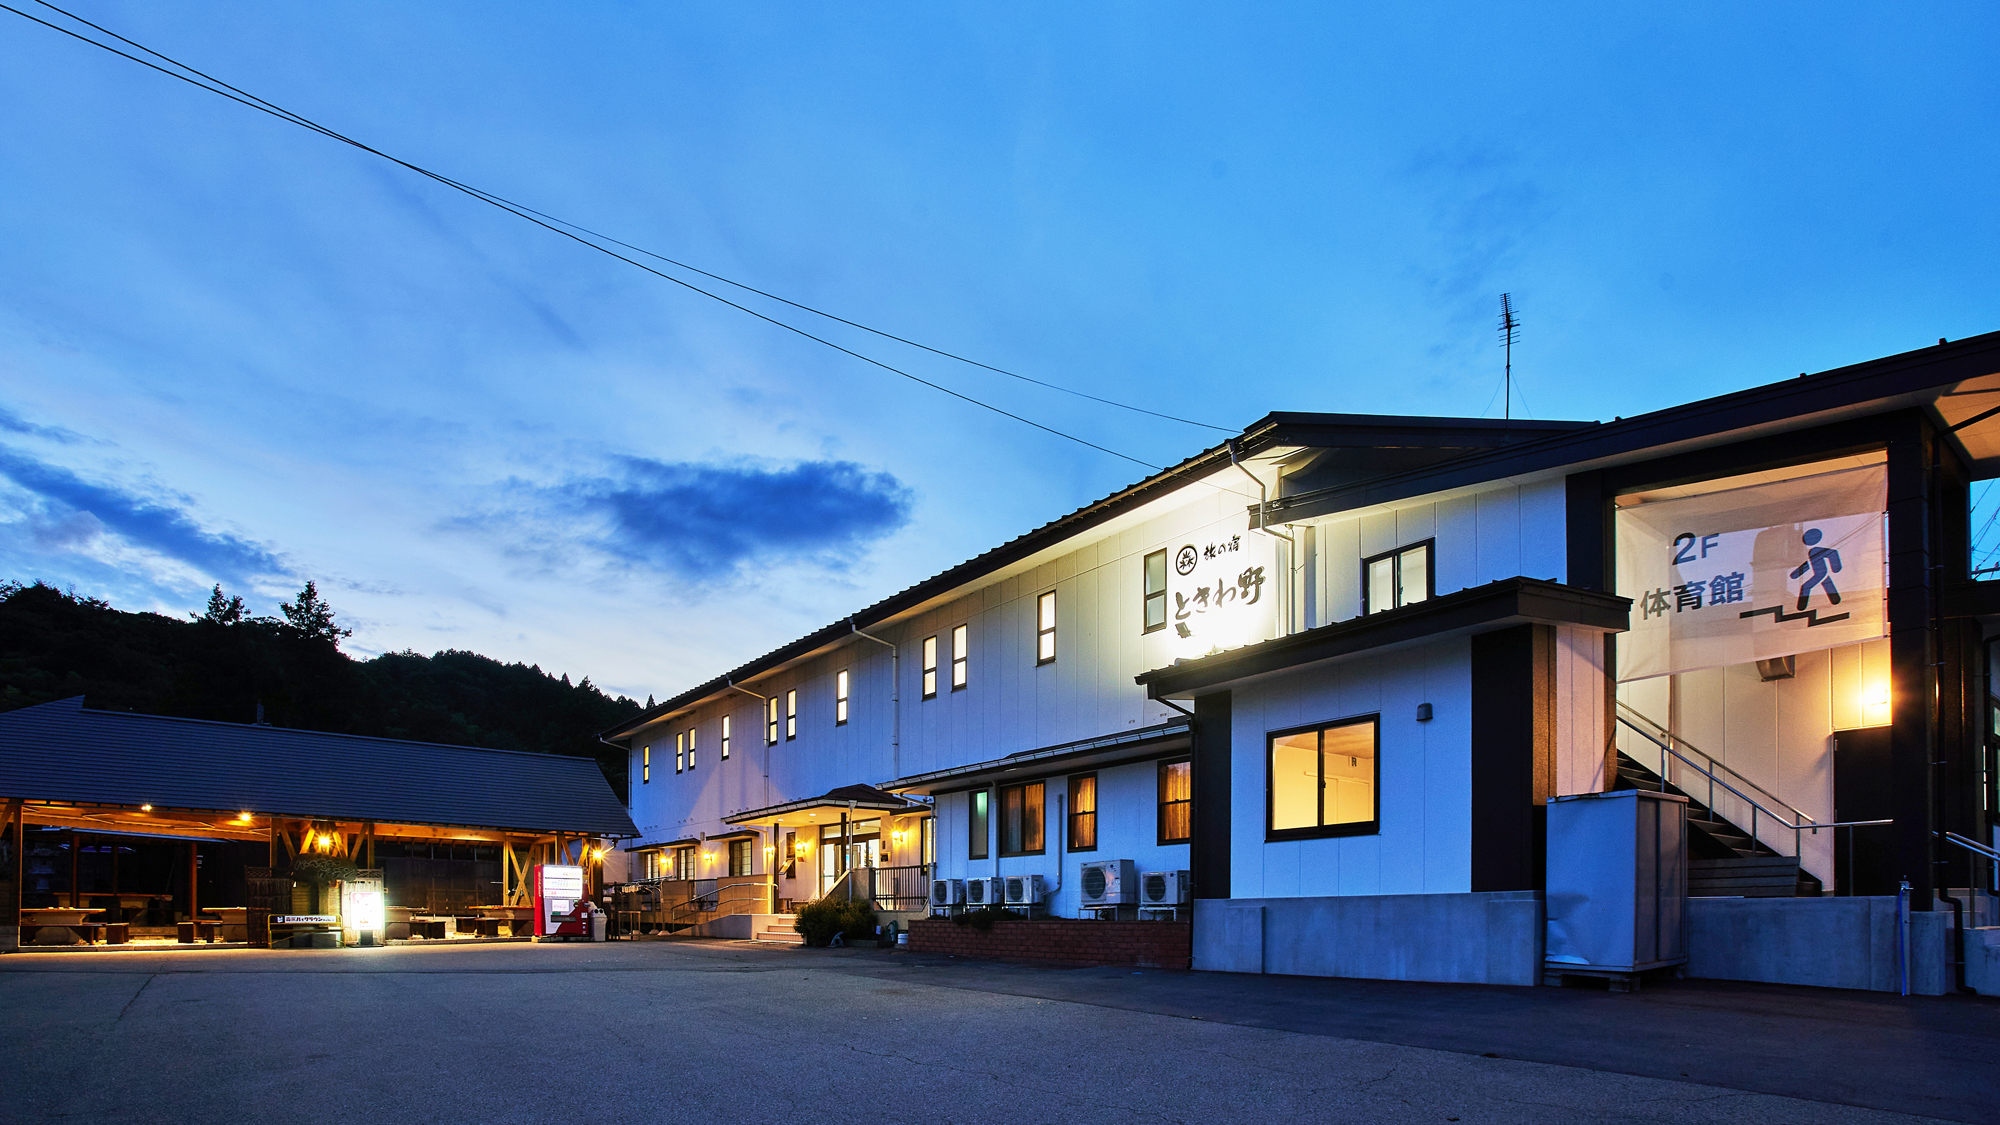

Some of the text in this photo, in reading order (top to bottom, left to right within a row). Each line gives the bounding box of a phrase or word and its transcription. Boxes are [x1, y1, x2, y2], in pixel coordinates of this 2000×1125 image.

[1672, 532, 1720, 565] 2F
[1175, 566, 1266, 620] ときわ野
[1640, 571, 1744, 620] 体育館
